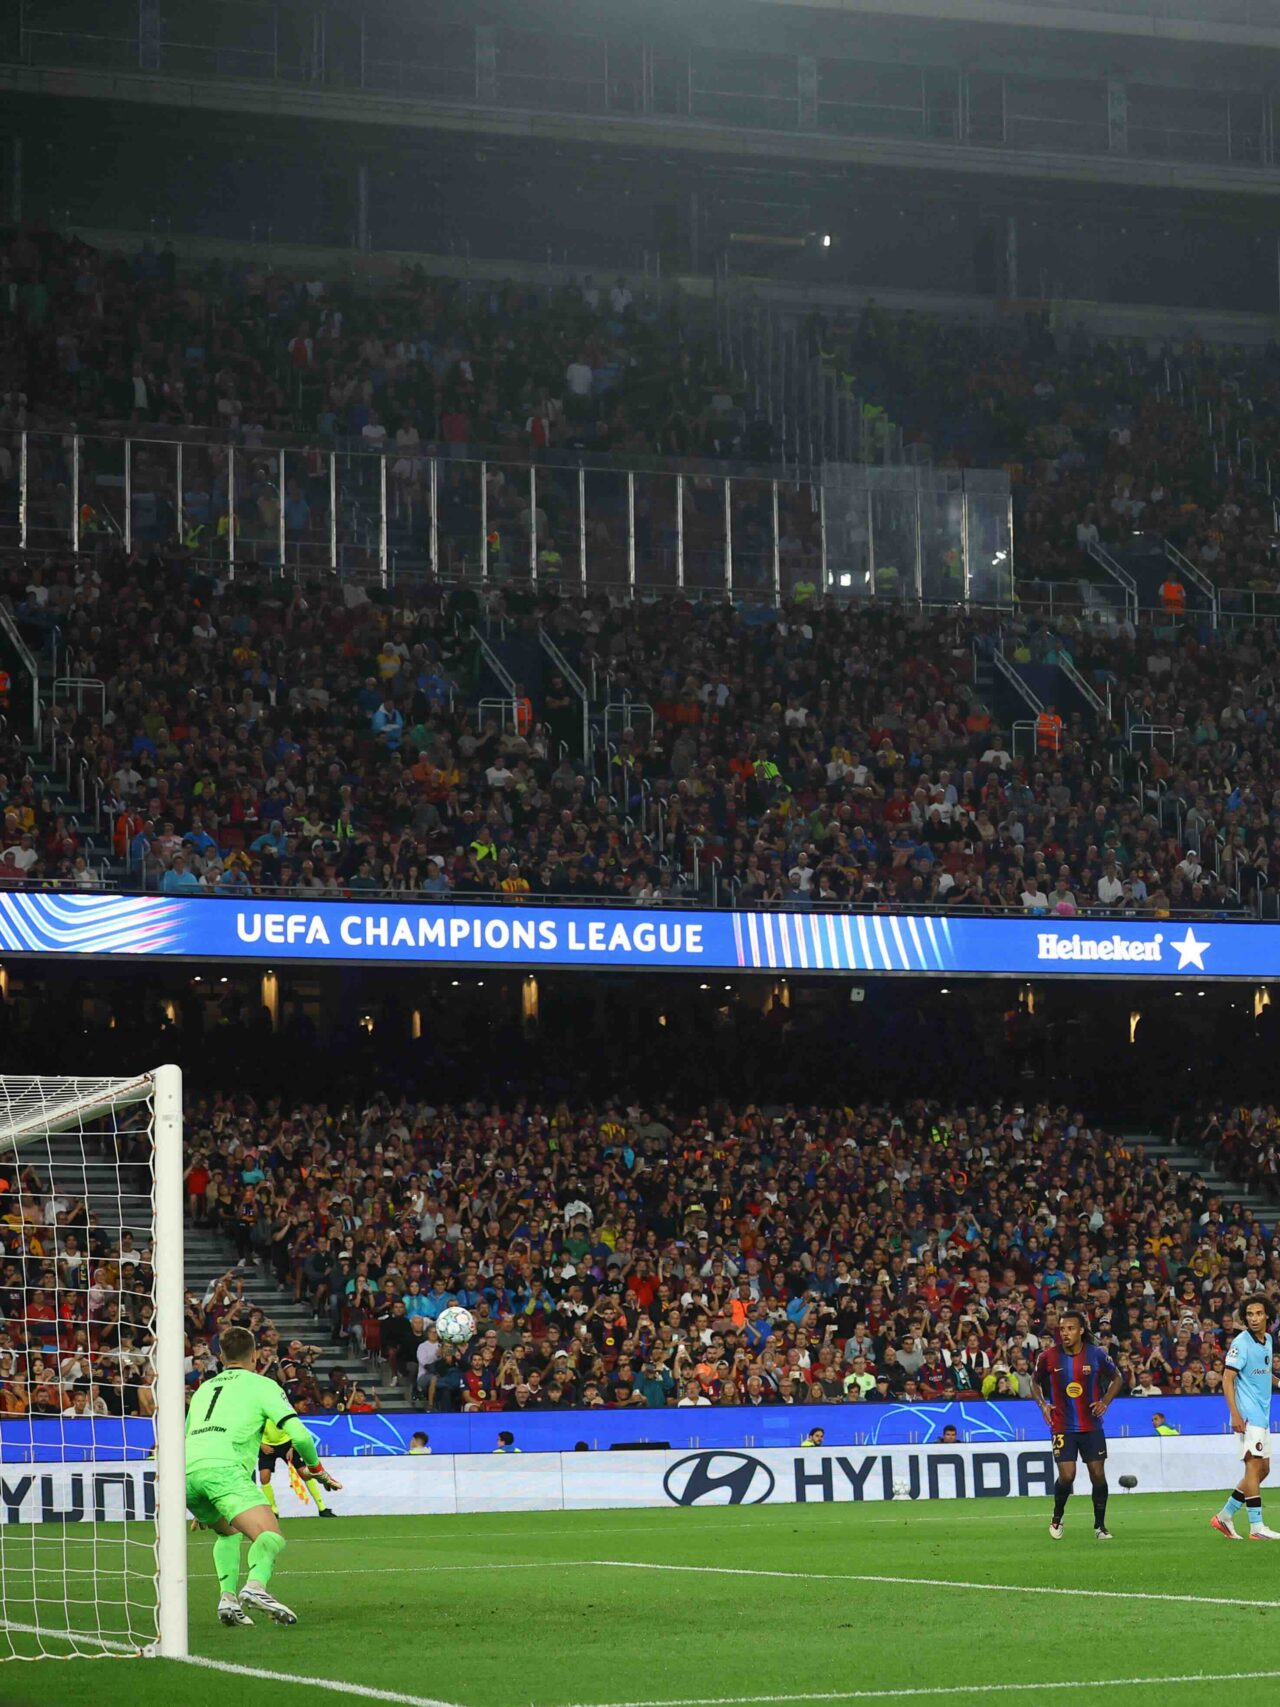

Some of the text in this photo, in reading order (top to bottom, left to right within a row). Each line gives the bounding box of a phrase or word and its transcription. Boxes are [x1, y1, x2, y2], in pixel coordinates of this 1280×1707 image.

[237, 913, 704, 953] UEFA CHAMPIONS LEAGUE
[1037, 933, 1161, 961] Heineken
[204, 1385, 223, 1422] 1
[794, 1451, 1055, 1503] HYUNDA
